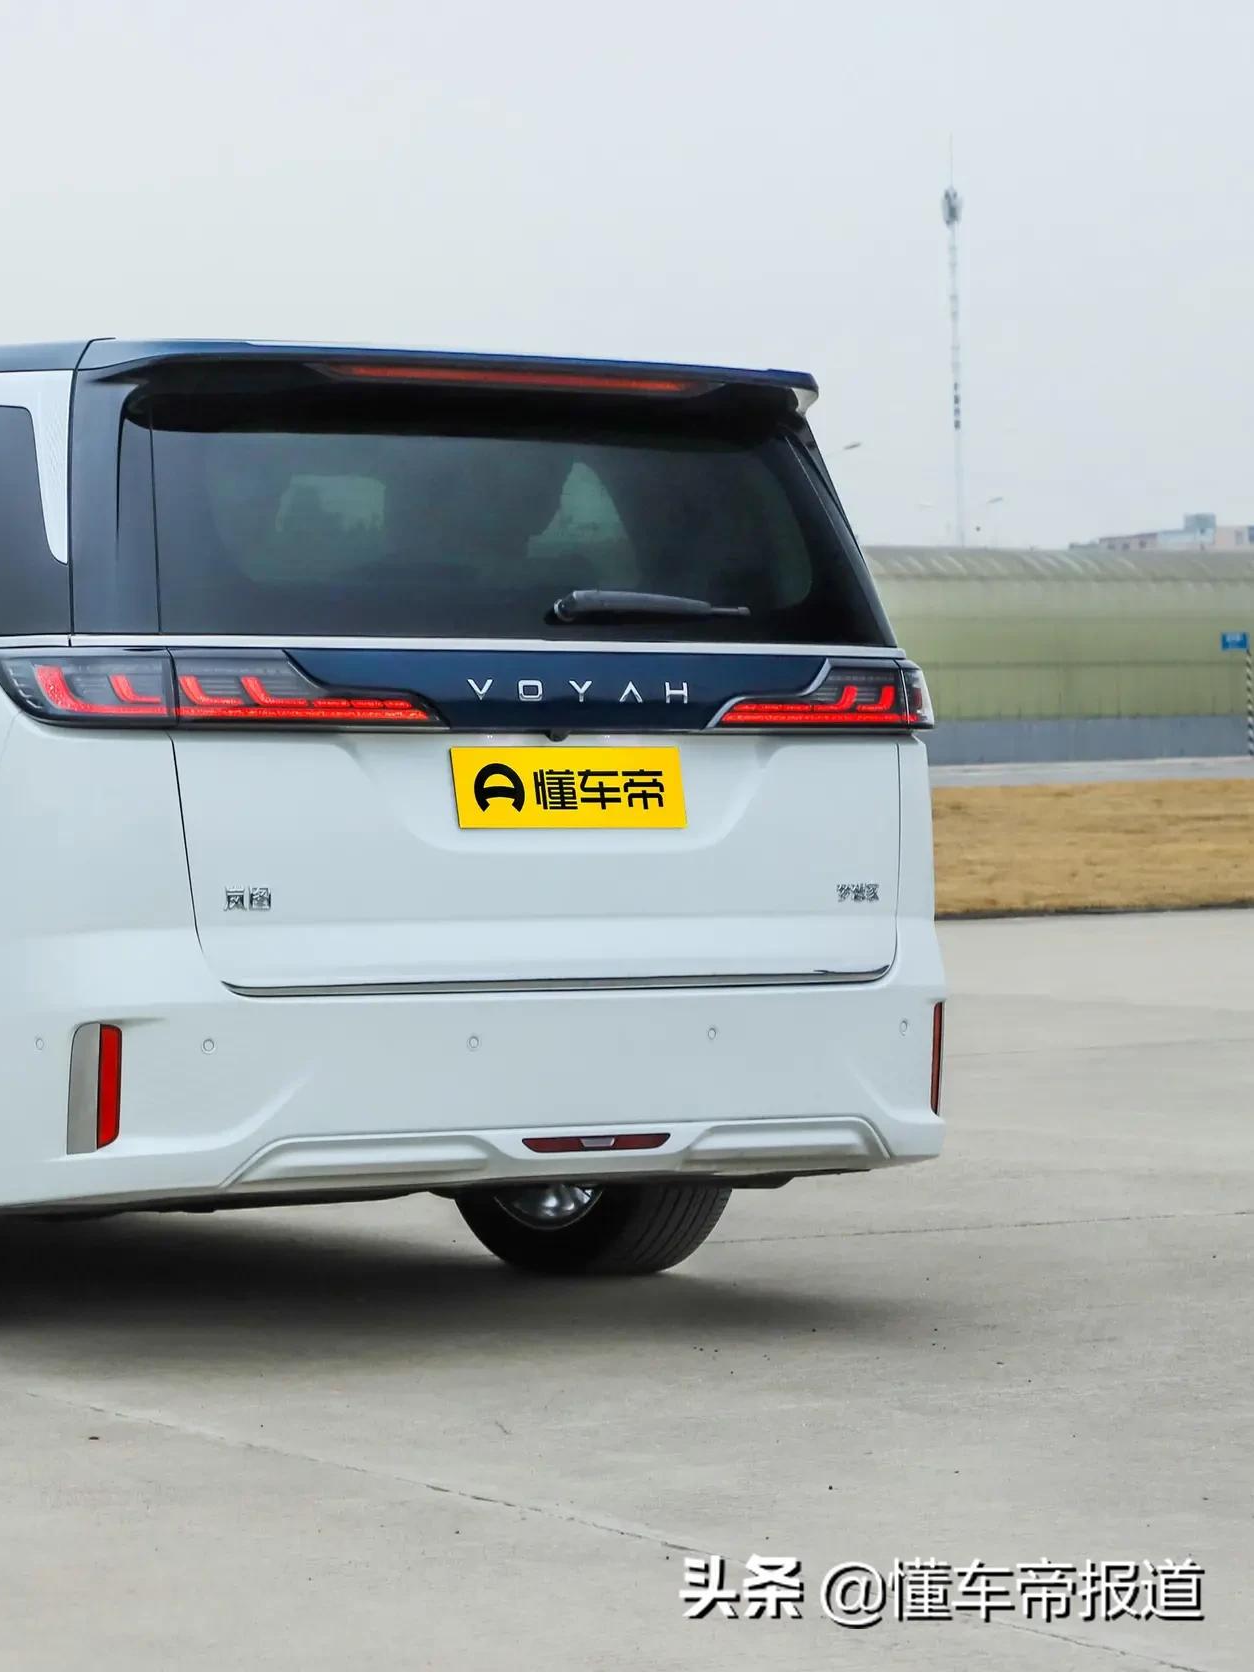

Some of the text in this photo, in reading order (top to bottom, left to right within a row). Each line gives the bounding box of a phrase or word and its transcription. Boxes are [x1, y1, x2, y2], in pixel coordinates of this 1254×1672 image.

[466, 678, 689, 704] VOYAH
[533, 769, 665, 810] 懂车帝
